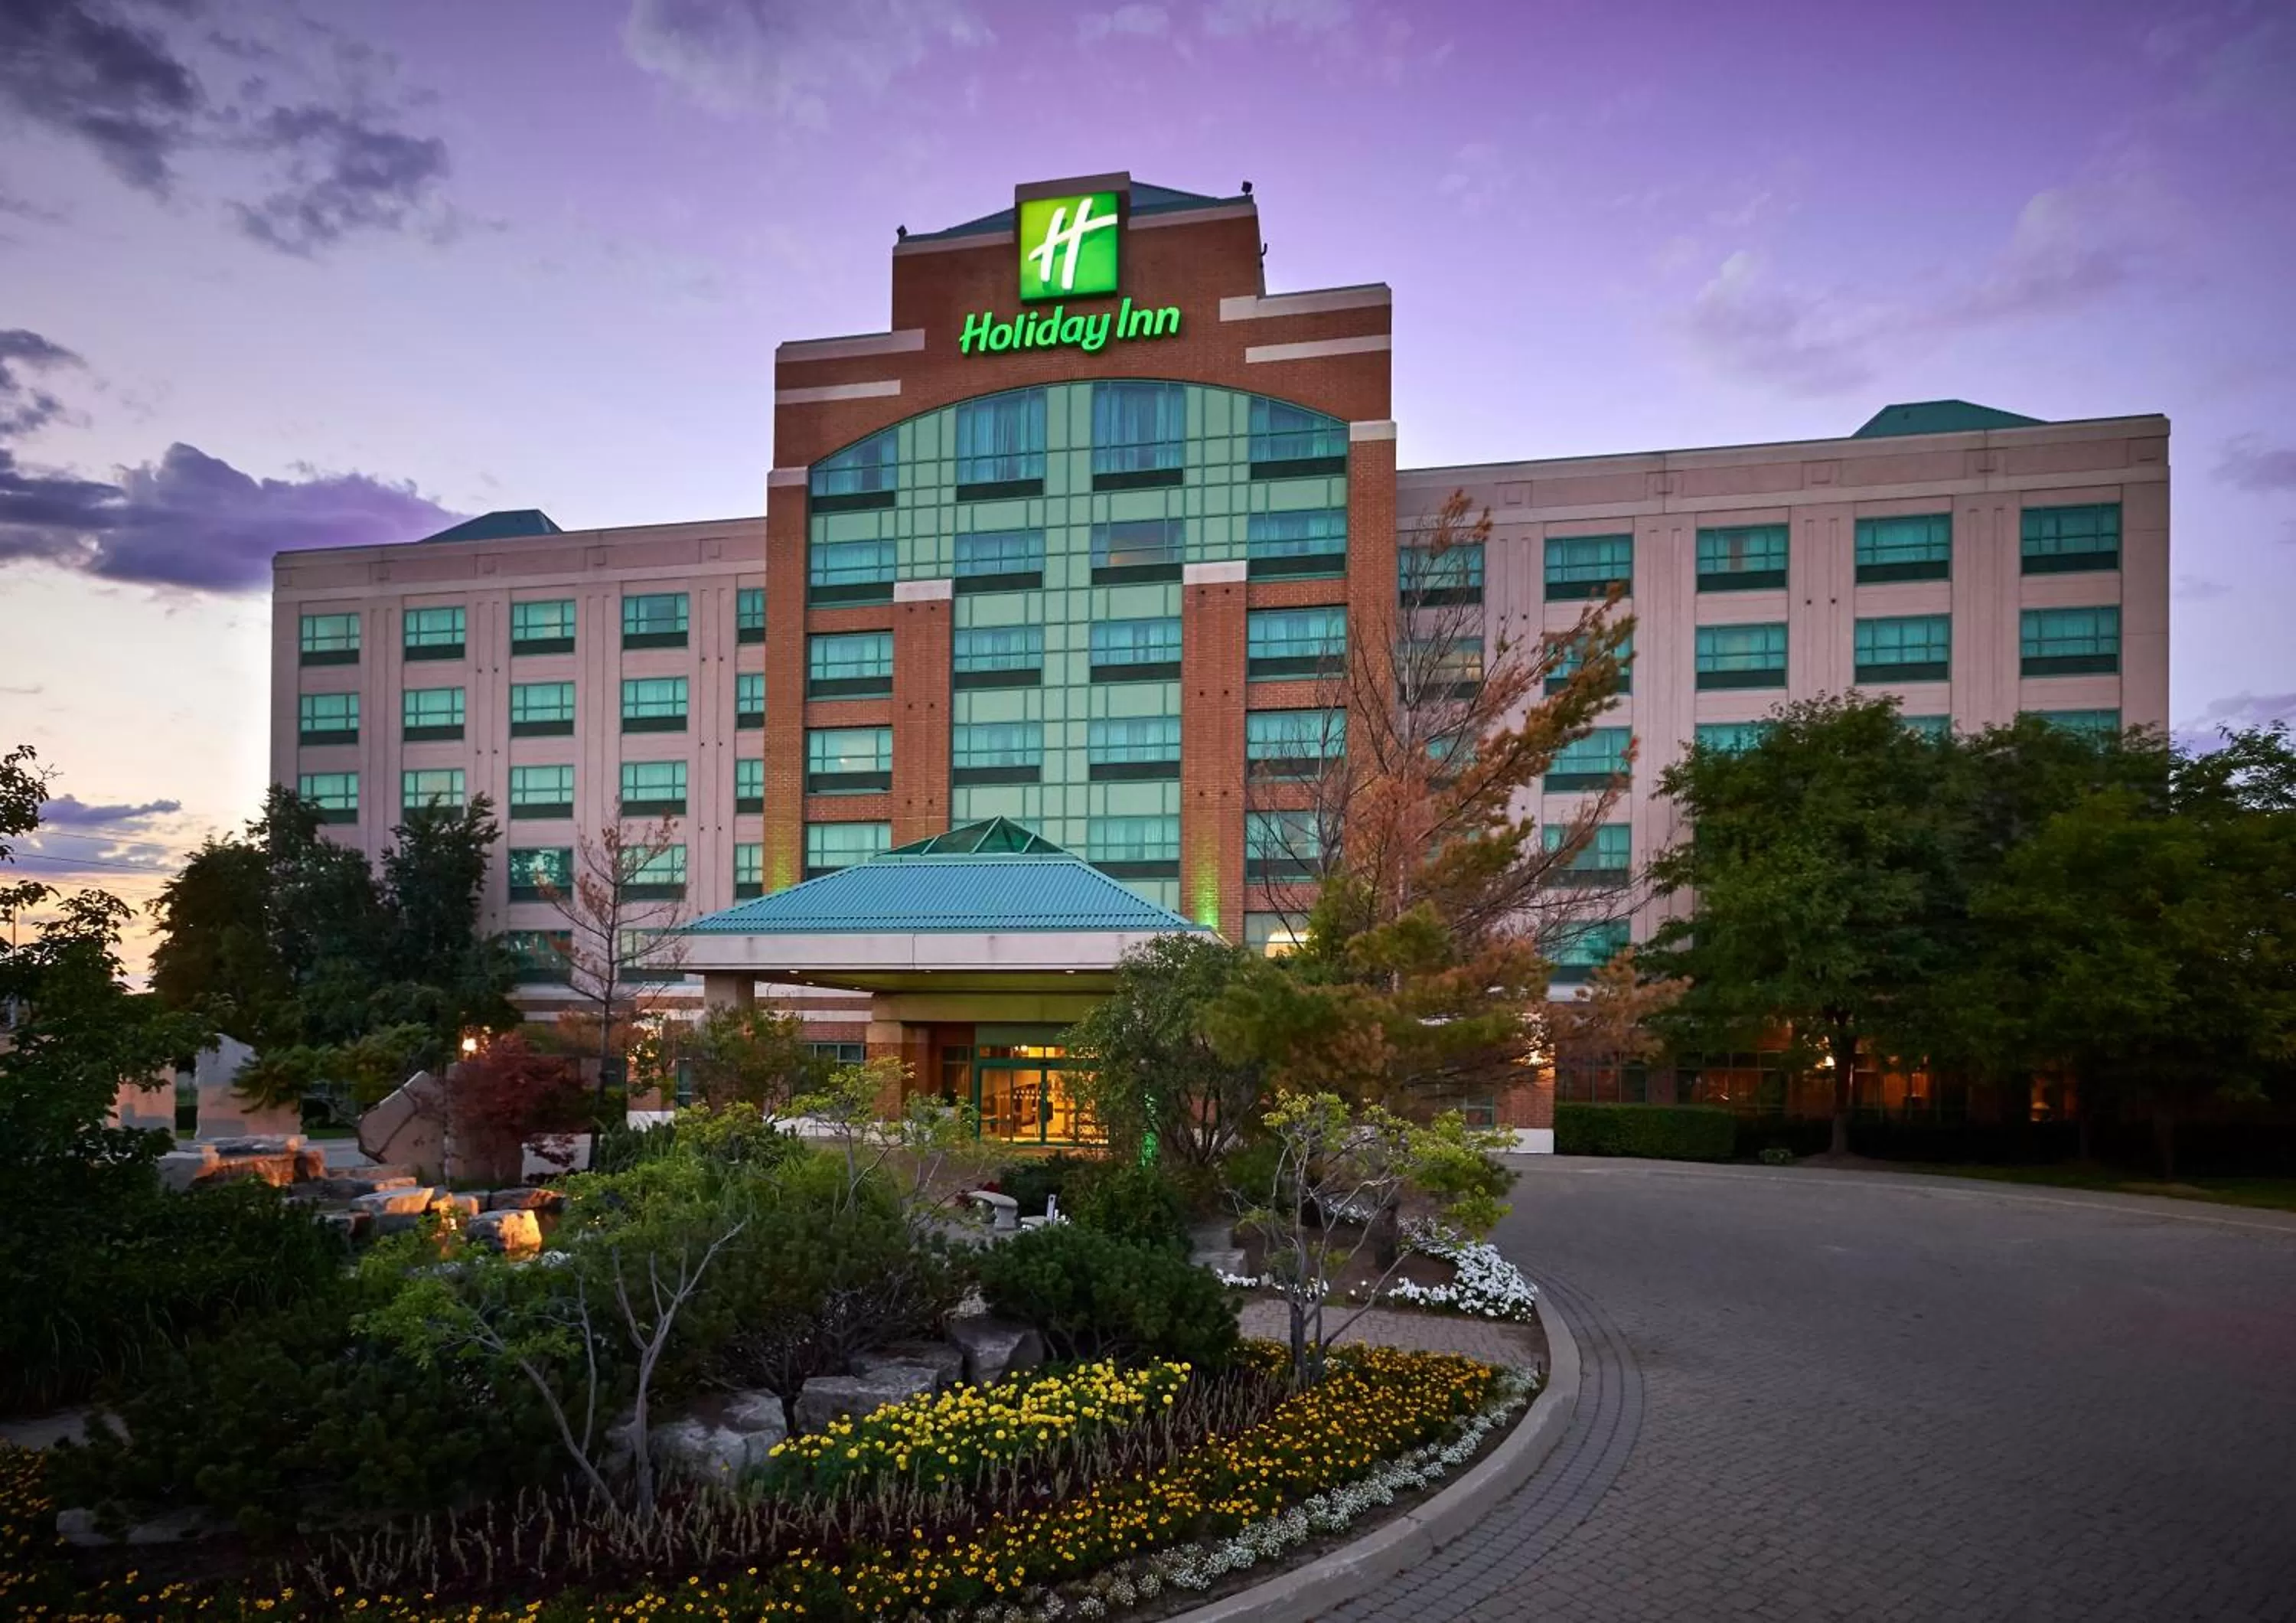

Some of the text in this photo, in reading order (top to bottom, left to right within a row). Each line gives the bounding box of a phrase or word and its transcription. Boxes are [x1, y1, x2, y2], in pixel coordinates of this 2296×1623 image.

[1028, 198, 1117, 290] H
[959, 297, 1180, 354] Holiday Inn
